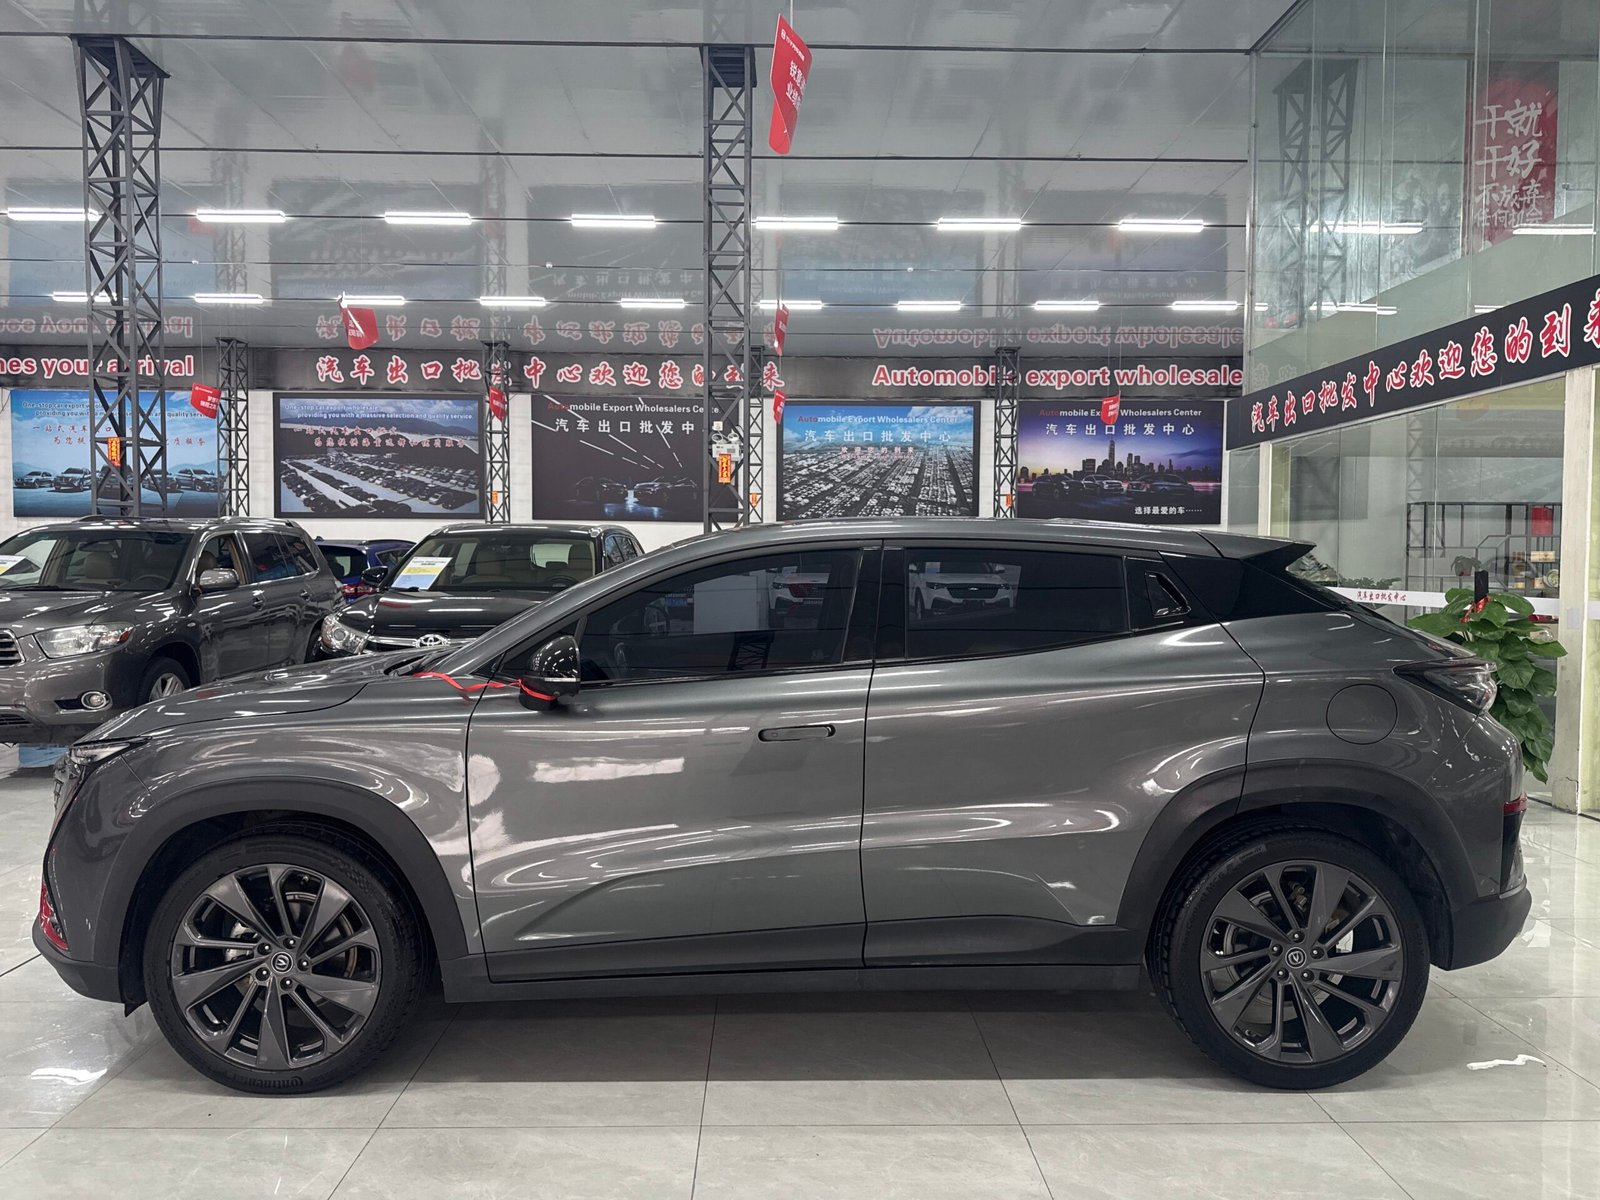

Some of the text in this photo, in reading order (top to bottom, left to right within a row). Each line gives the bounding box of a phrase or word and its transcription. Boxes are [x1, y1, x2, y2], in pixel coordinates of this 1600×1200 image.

[1475, 139, 1545, 181] 干好
[1474, 179, 1545, 208] 不放弃
[1026, 366, 1110, 390] export
[1115, 365, 1242, 385] wholesale
[64, 402, 85, 410] export
[602, 403, 633, 413] Export
[635, 403, 691, 413] Wholesalers
[35, 410, 65, 418] providing
[167, 410, 189, 419] quality
[297, 412, 327, 420] providing
[1039, 408, 1088, 417] Automobile
[1120, 408, 1172, 417] Wholesalers
[1173, 408, 1202, 417] Center
[797, 415, 959, 425] Automobile Export Wholesalers Center
[1046, 423, 1195, 436] 汽车出口批发中心
[805, 429, 952, 442] 汽车出口批发中心
